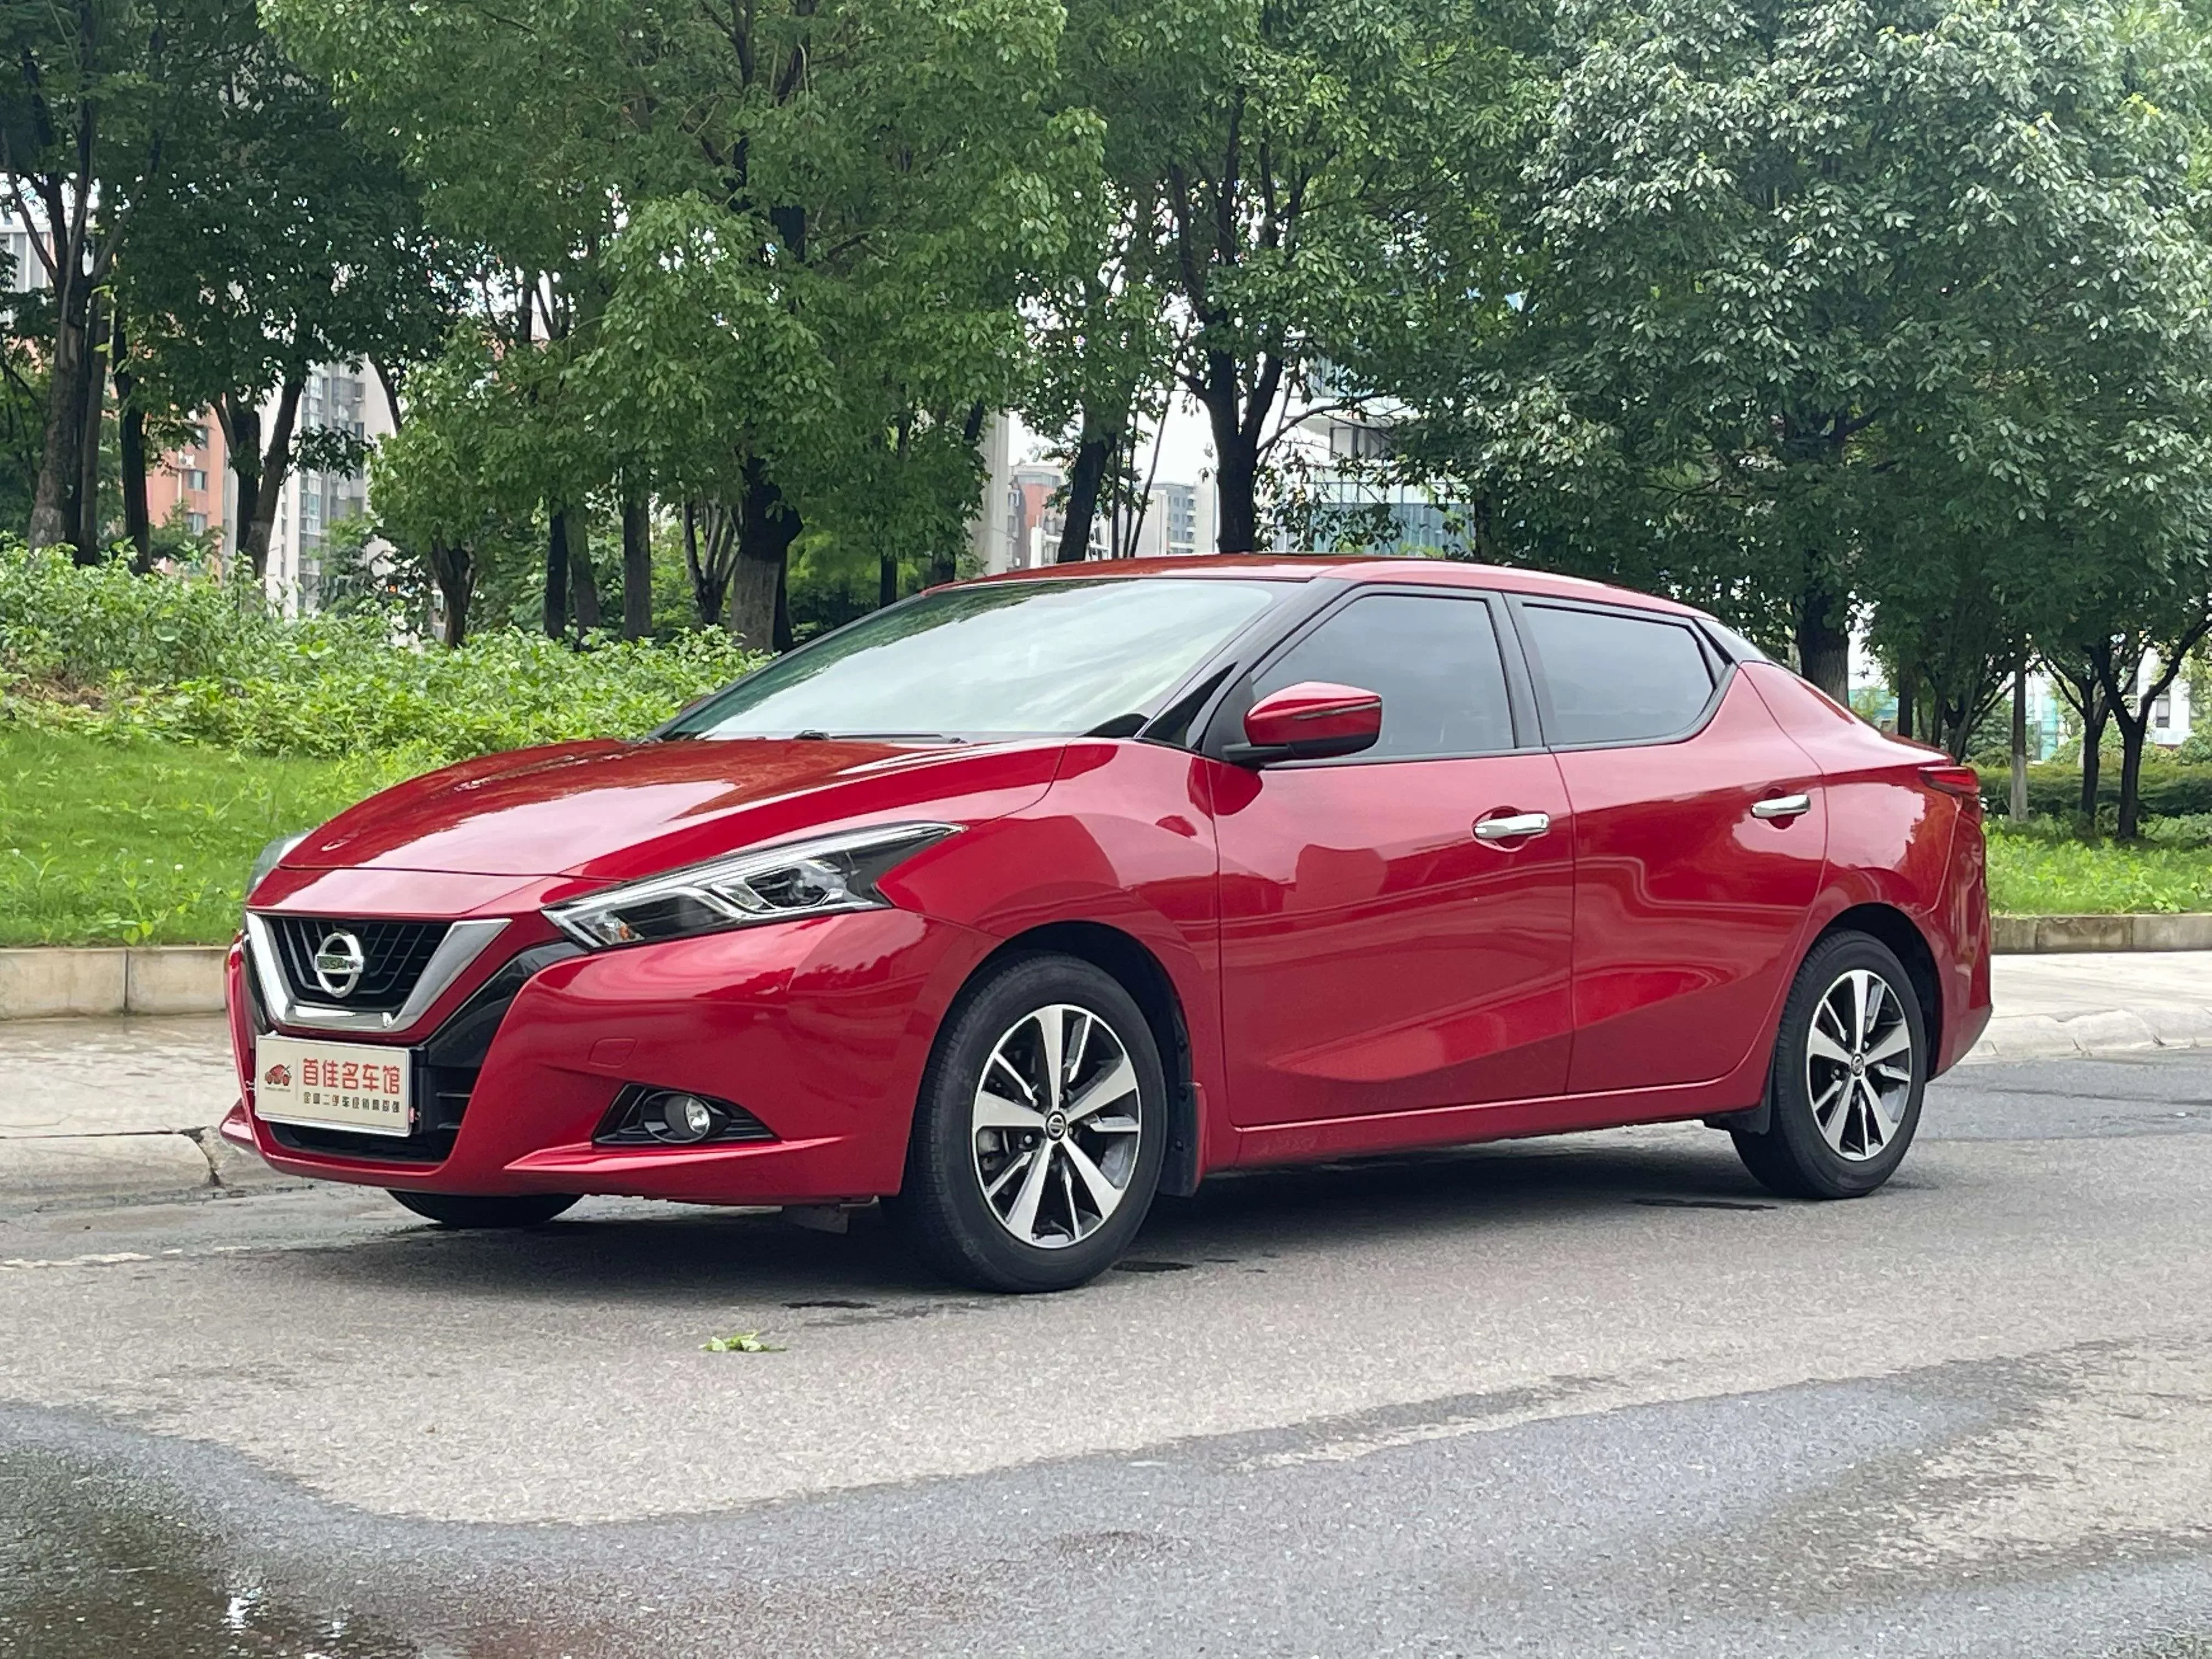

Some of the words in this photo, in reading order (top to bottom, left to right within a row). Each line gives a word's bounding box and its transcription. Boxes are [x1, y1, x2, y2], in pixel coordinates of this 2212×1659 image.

[303, 1058, 400, 1094] 首佳名车馆
